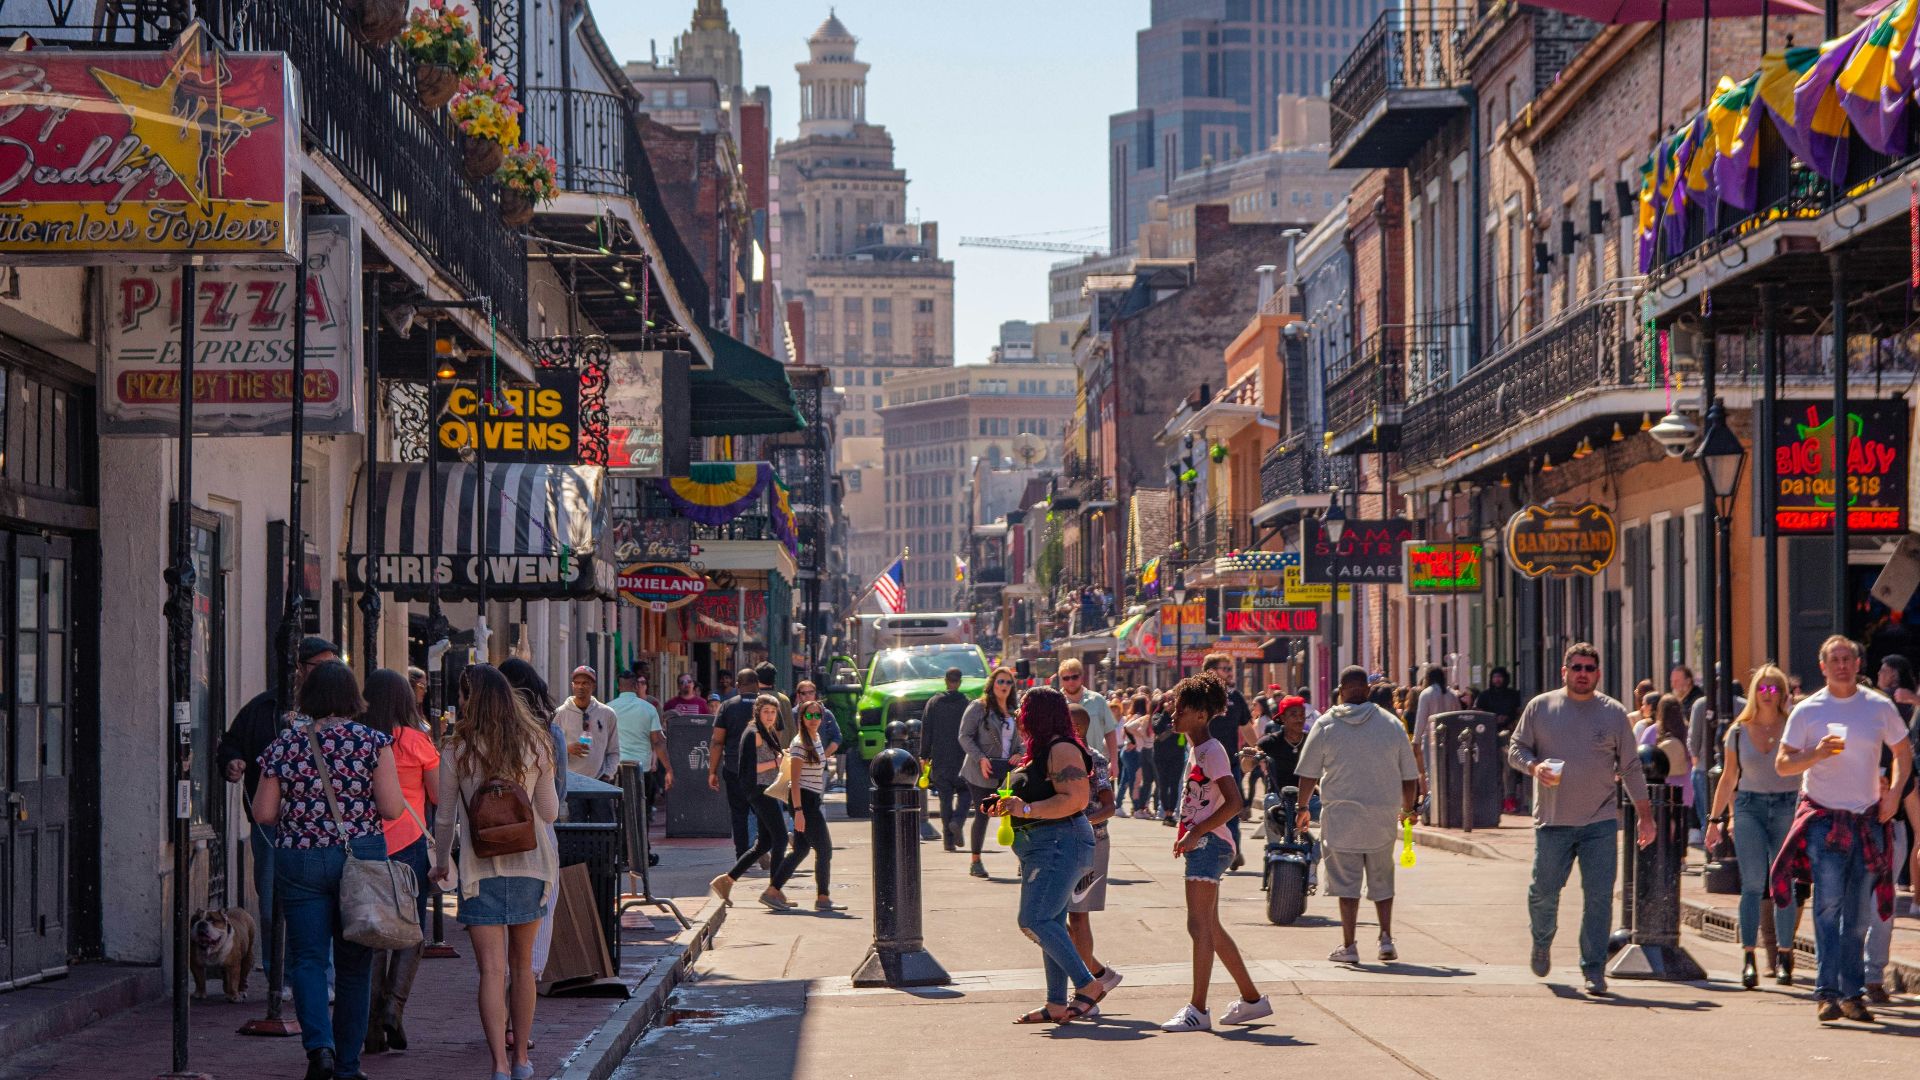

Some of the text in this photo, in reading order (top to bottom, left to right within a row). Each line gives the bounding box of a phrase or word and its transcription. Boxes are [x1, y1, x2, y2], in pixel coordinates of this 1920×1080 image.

[0, 207, 279, 248] ttomless Topless
[120, 274, 337, 333] PIZZA
[226, 371, 265, 398] THE
[272, 372, 331, 398] SLCE
[439, 421, 571, 450] OWENS
[1776, 436, 1896, 474] BIG ASY
[1315, 543, 1402, 556] SUTR
[1518, 532, 1611, 553] BANDSTAND
[357, 556, 453, 584] CHRIS
[466, 556, 580, 584] OWENS
[617, 576, 705, 592] DIXIELAND
